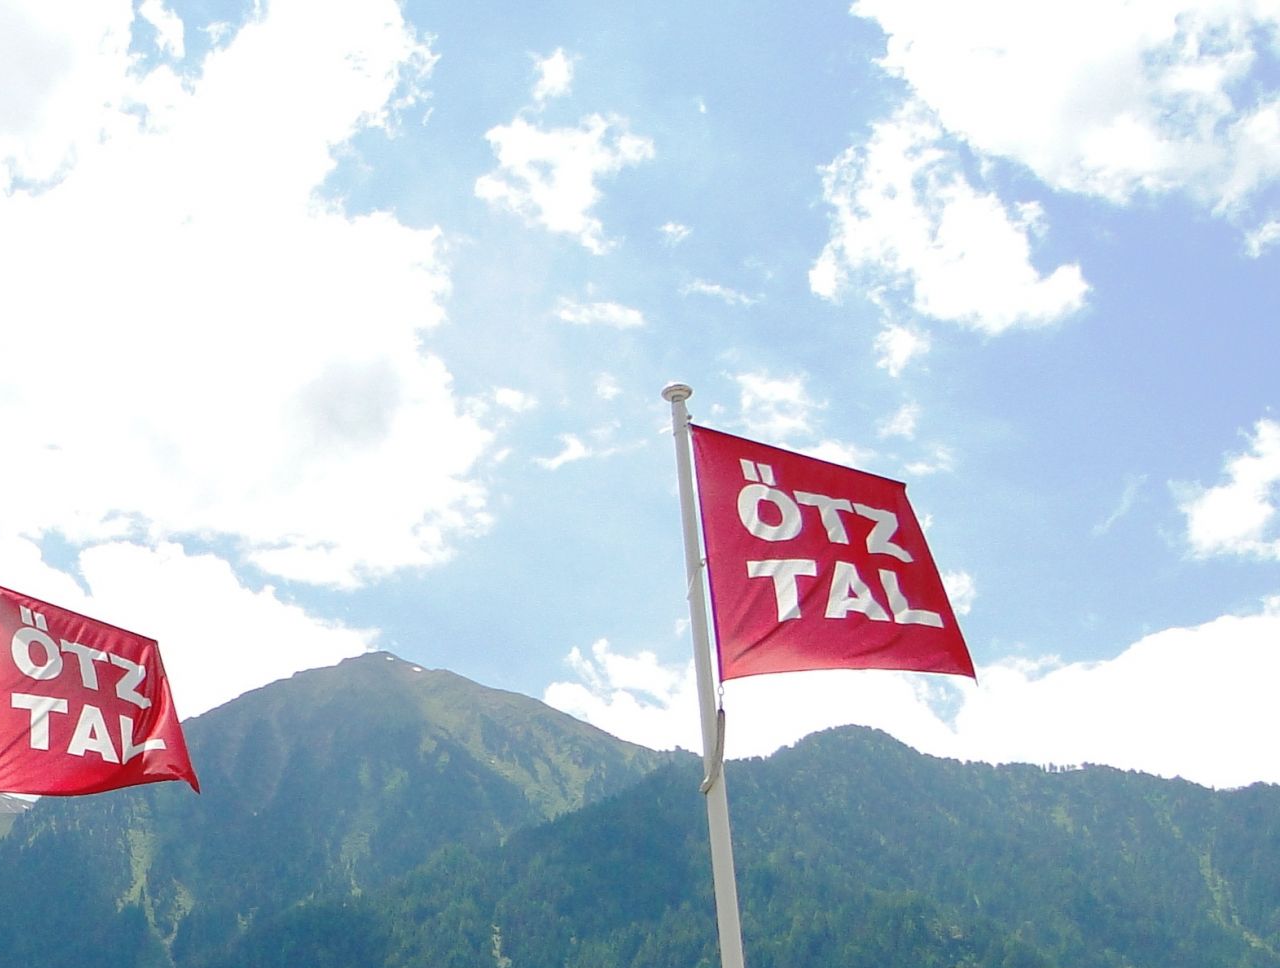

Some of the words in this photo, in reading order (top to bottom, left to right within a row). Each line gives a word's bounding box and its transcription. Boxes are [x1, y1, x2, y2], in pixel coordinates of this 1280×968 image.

[737, 458, 914, 563] ÖTZ
[745, 558, 945, 629] TAL
[10, 605, 152, 709] ÖTZ
[10, 692, 167, 765] TAL
